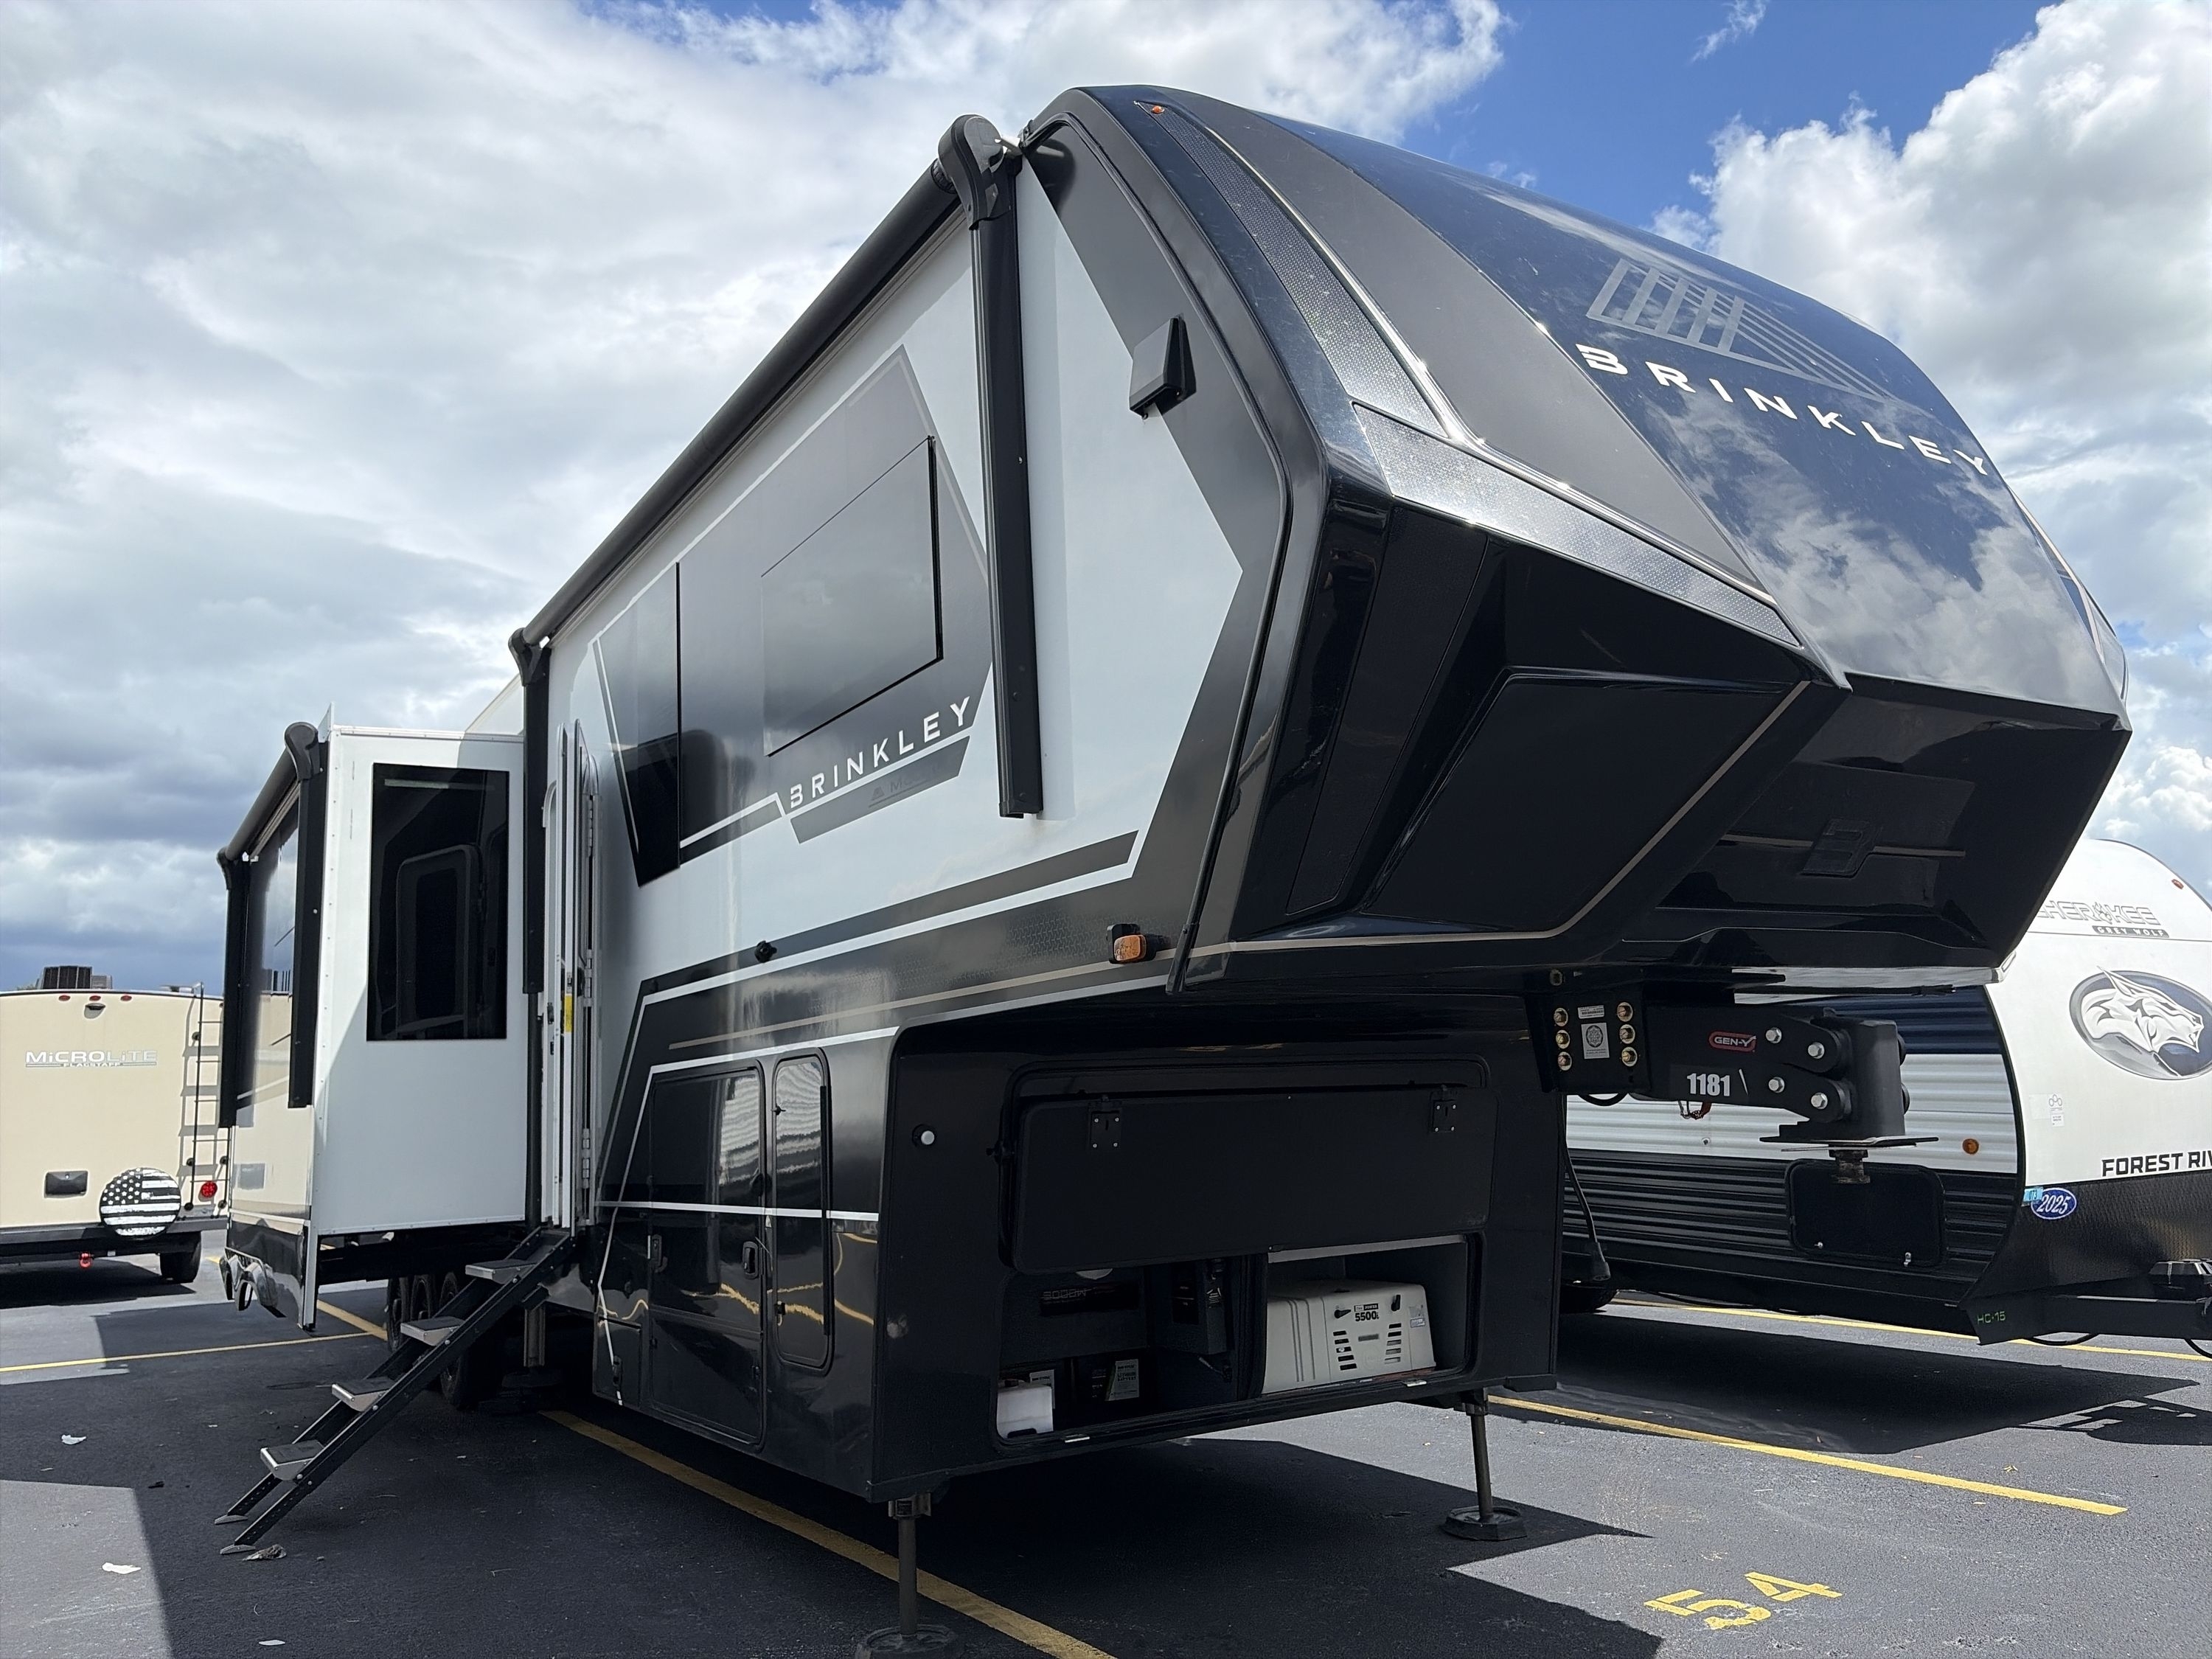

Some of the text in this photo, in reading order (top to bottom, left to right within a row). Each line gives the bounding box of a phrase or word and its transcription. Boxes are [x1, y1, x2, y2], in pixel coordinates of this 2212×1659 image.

[1575, 343, 1988, 476] BRINKLEY
[790, 696, 970, 810] BRINKLEY
[2037, 900, 2161, 925] HEROKEE
[2097, 926, 2165, 936] GREY WOLF
[1714, 1036, 1756, 1047] GEN-Y
[1686, 1073, 1731, 1097] 1181
[2101, 1152, 2183, 1177] FOREST
[2036, 1194, 2072, 1215] 2025
[1644, 1571, 1843, 1630] 54
